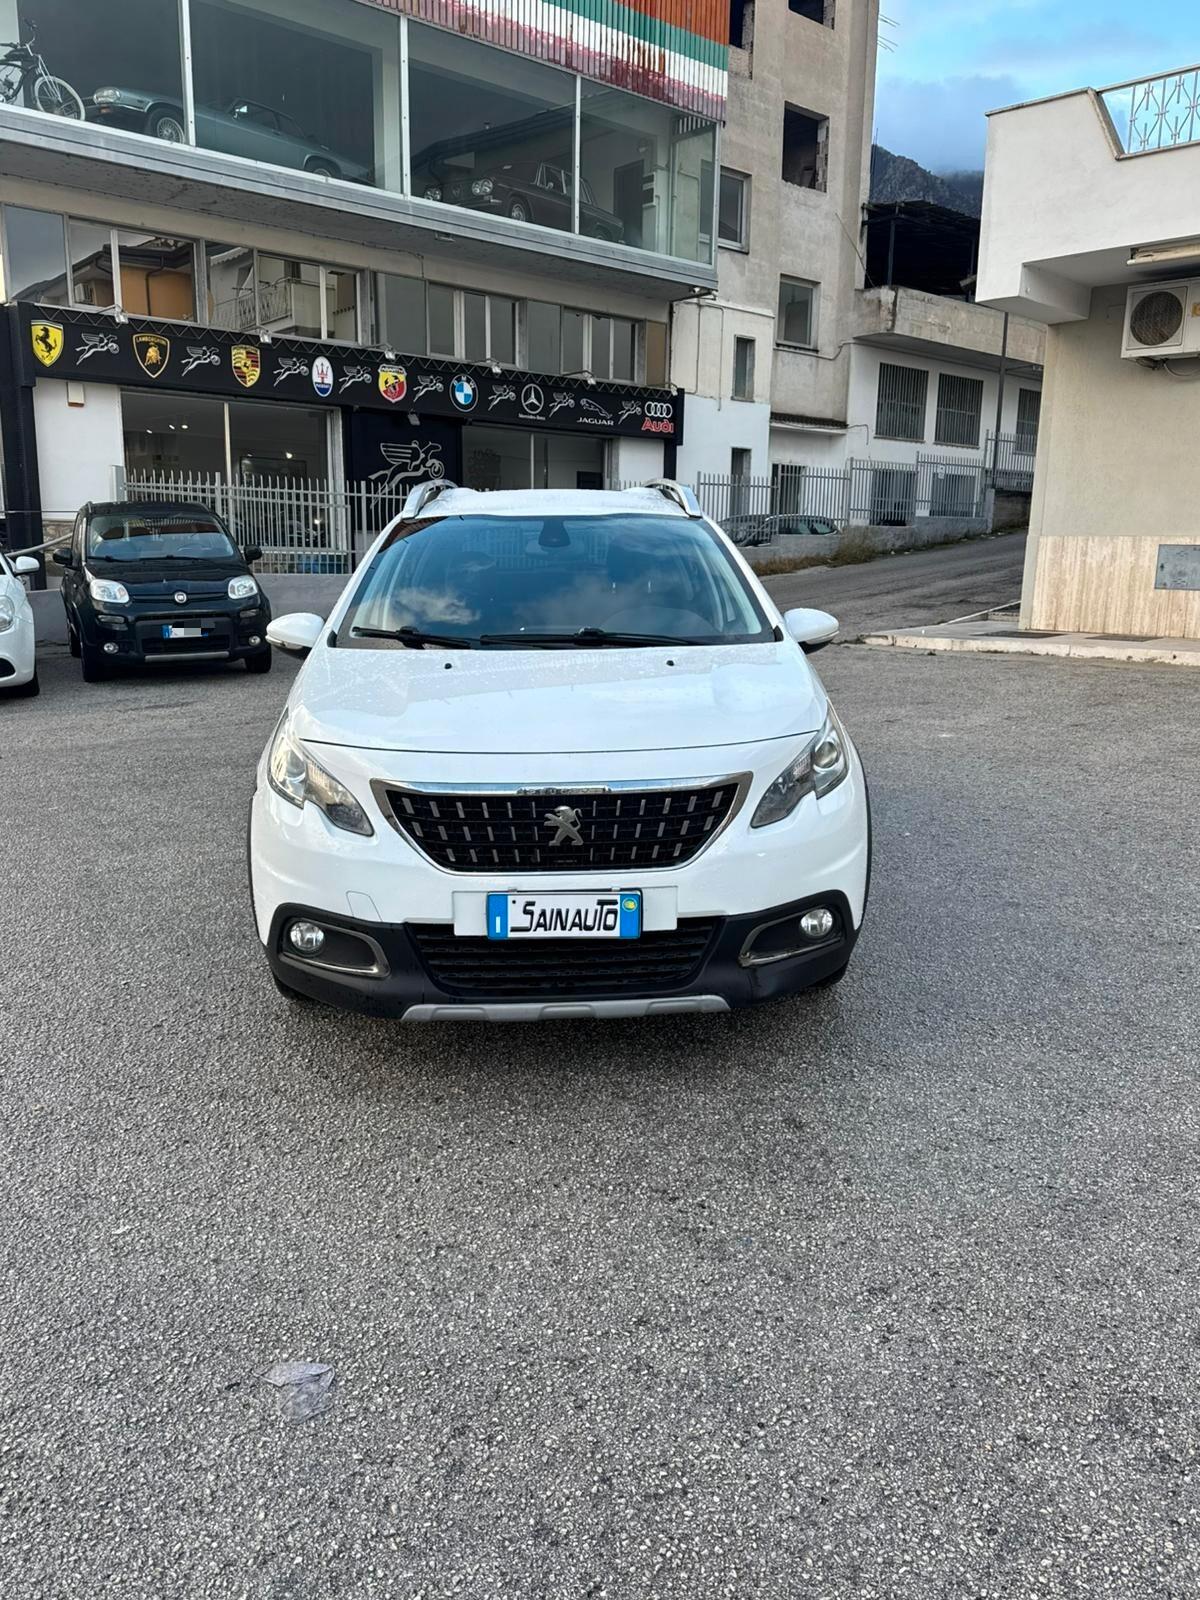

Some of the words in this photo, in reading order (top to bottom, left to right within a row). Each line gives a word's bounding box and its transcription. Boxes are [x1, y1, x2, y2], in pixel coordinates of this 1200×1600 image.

[576, 416, 615, 426] JAGUAR
[641, 417, 675, 433] Audi
[509, 898, 619, 933] SAINAUTO
